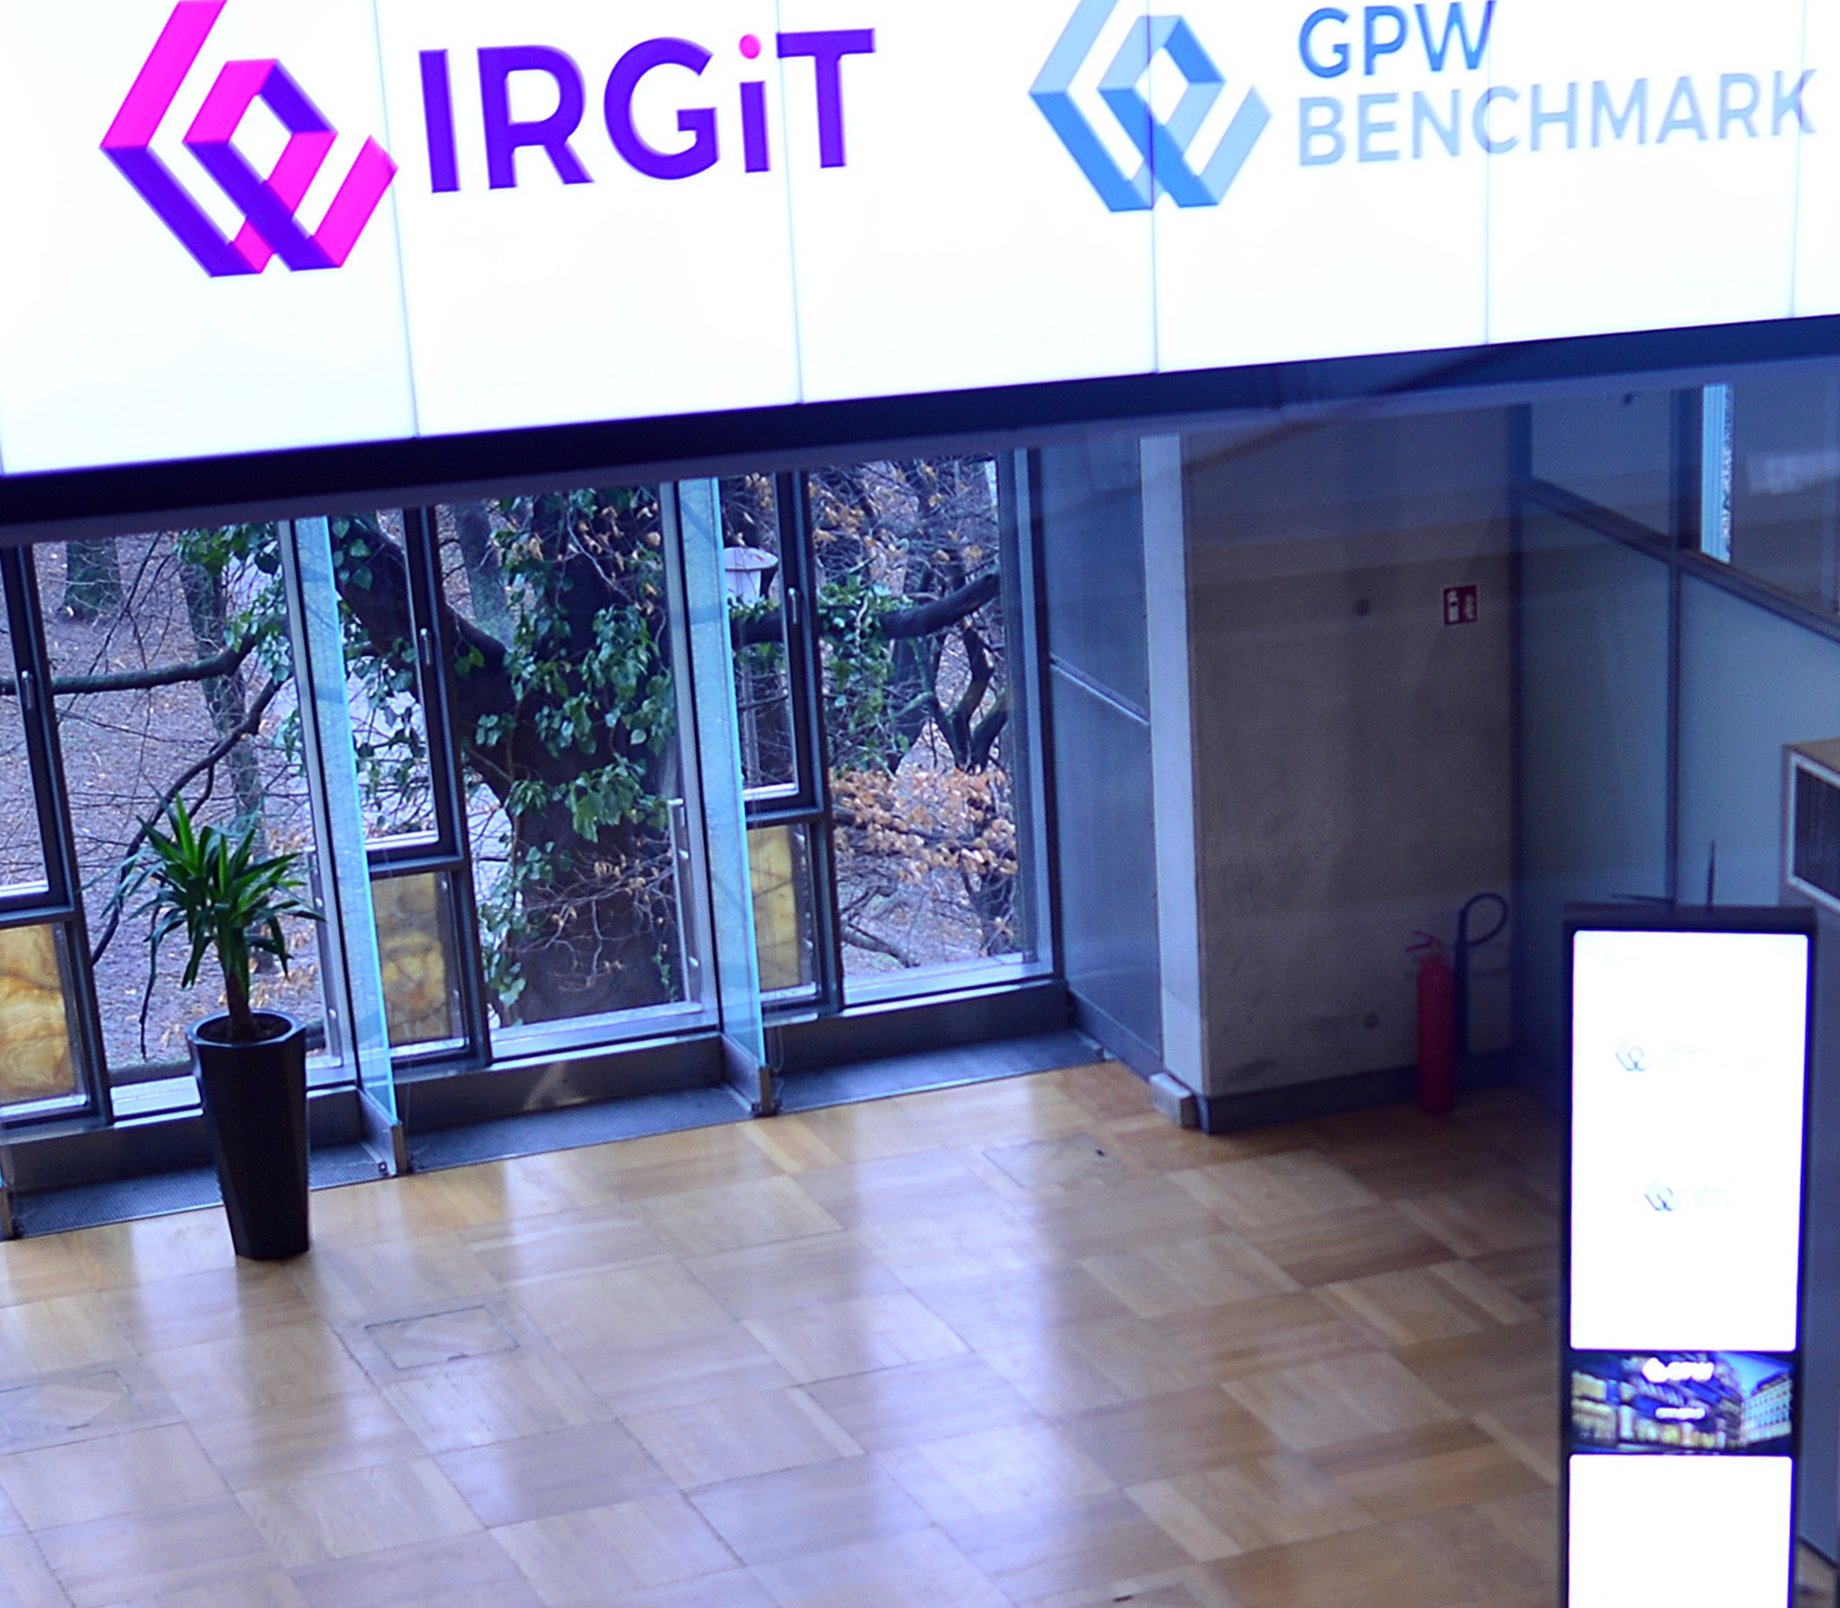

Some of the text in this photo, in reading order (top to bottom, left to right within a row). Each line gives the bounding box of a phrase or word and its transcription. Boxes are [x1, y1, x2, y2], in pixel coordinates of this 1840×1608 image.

[1298, 0, 1498, 79] GPW
[419, 28, 876, 193] IRGiT
[1298, 69, 1818, 167] BENCHMARK
